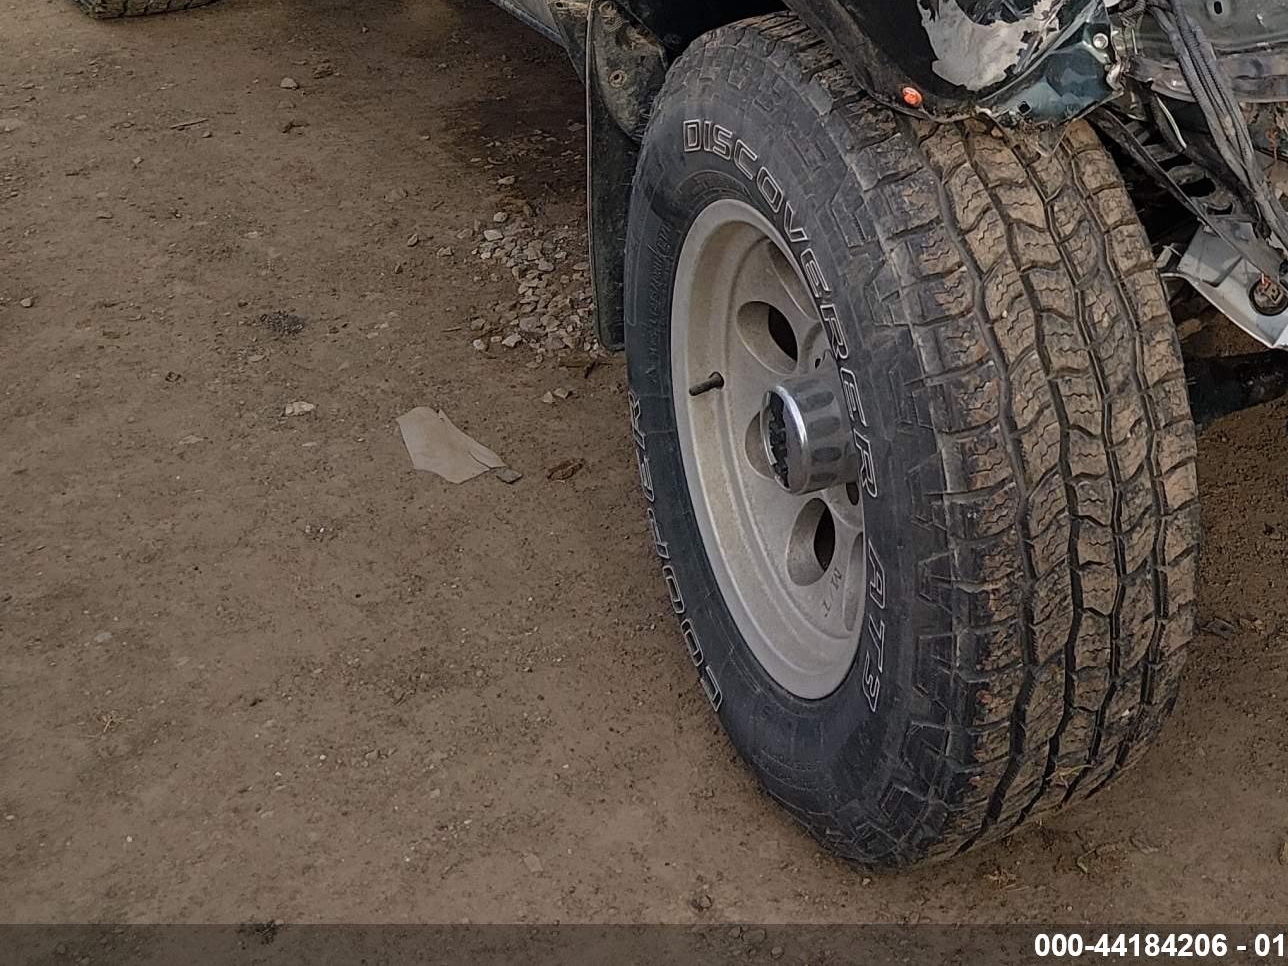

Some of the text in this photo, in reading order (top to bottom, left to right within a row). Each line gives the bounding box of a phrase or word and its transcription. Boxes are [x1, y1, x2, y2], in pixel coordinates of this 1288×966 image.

[627, 390, 723, 713] COOPER
[682, 118, 886, 713] DISCOVERER AT3
